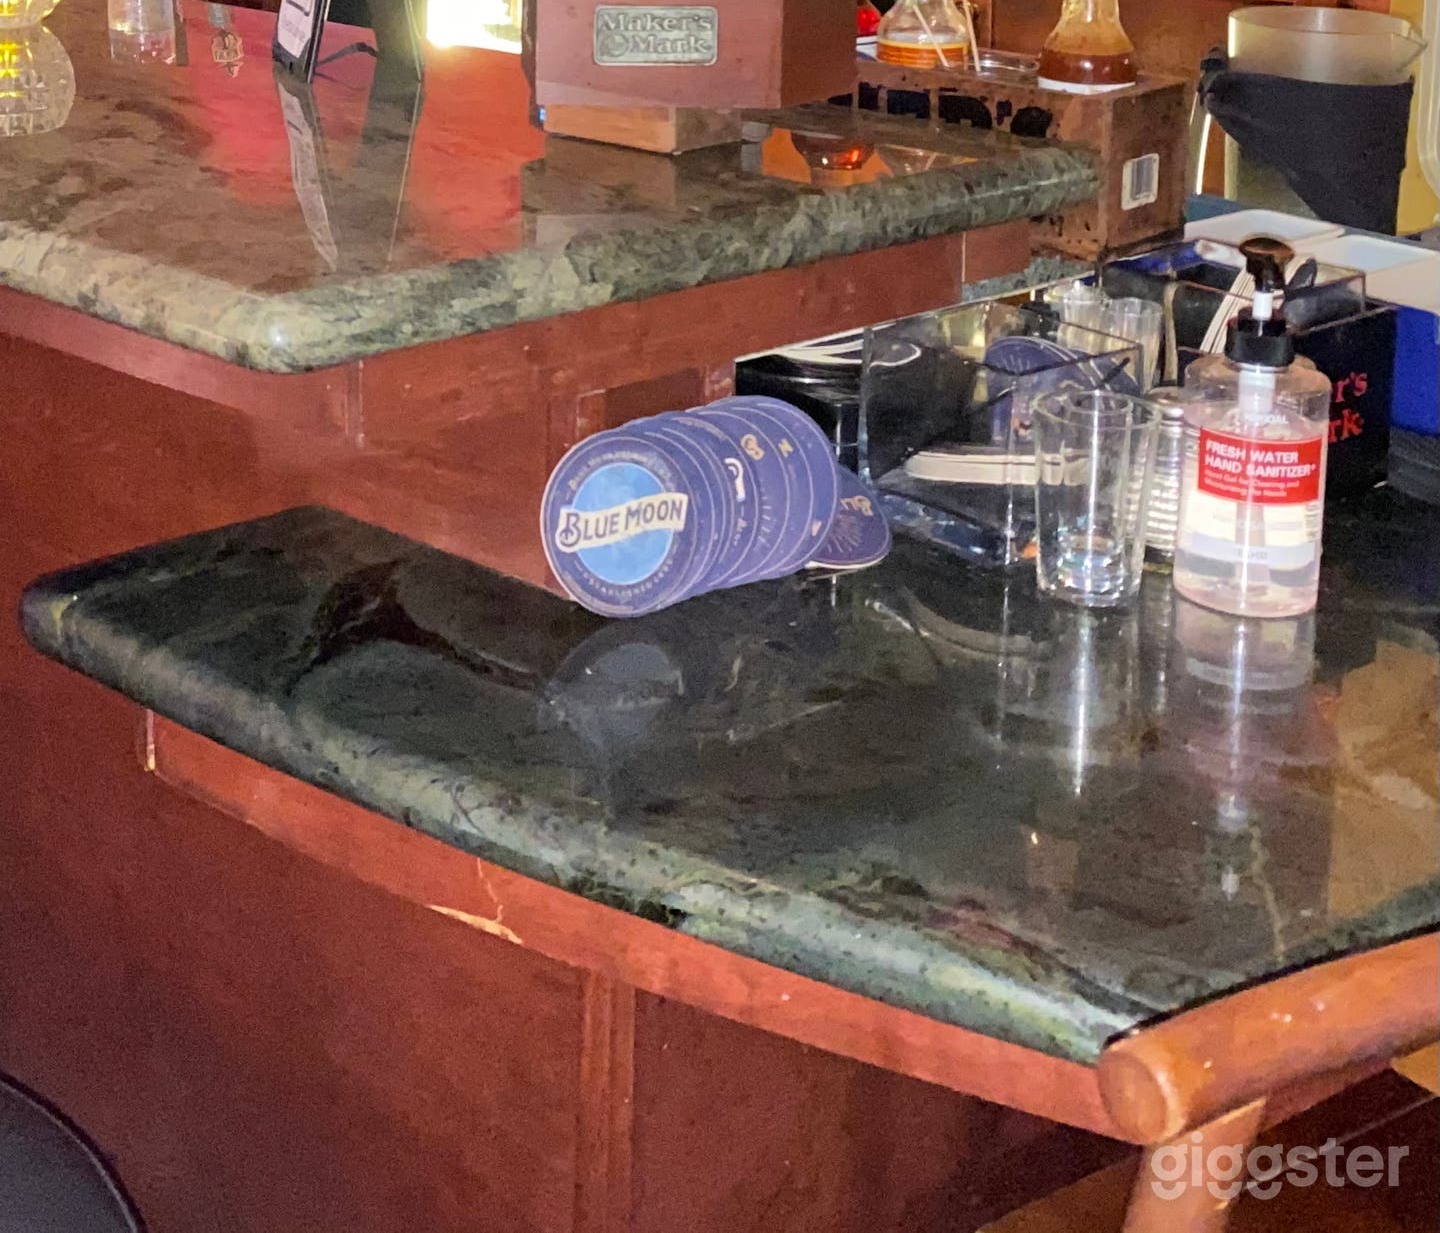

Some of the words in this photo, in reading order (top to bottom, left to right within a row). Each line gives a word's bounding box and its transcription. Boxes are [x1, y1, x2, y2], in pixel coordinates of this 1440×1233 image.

[601, 13, 713, 31] Maker's
[630, 34, 713, 53] Mark
[1205, 439, 1247, 460] FRESH
[1250, 450, 1299, 464] WATER
[1204, 454, 1242, 473] HAND
[560, 512, 620, 548] BLUE
[624, 499, 684, 531] MOON
